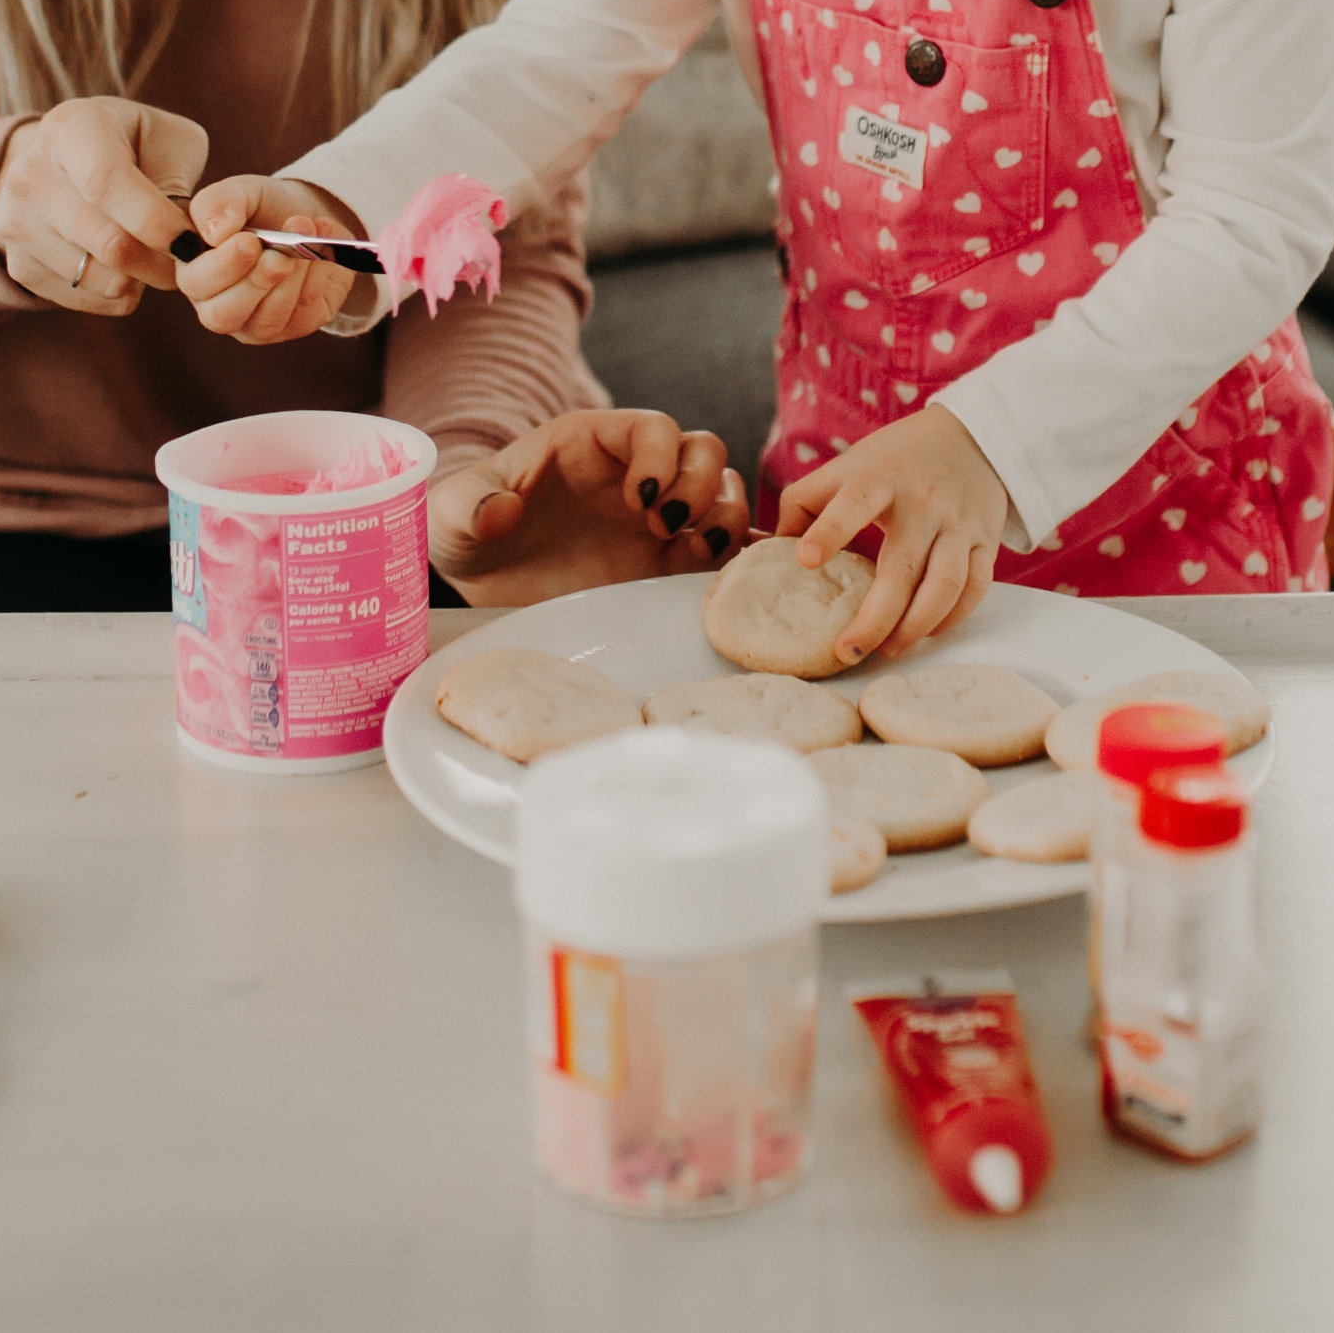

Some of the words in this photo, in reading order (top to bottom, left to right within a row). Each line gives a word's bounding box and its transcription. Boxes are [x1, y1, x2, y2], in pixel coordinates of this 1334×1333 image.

[857, 116, 916, 154] OSHKOSH
[287, 516, 379, 539] Nutrition
[288, 539, 347, 556] Facts
[301, 565, 340, 576] servings
[314, 575, 334, 584] size
[289, 602, 344, 616] Calories
[348, 597, 380, 620] 140
[307, 616, 340, 625] serving
[256, 661, 270, 673] 140
